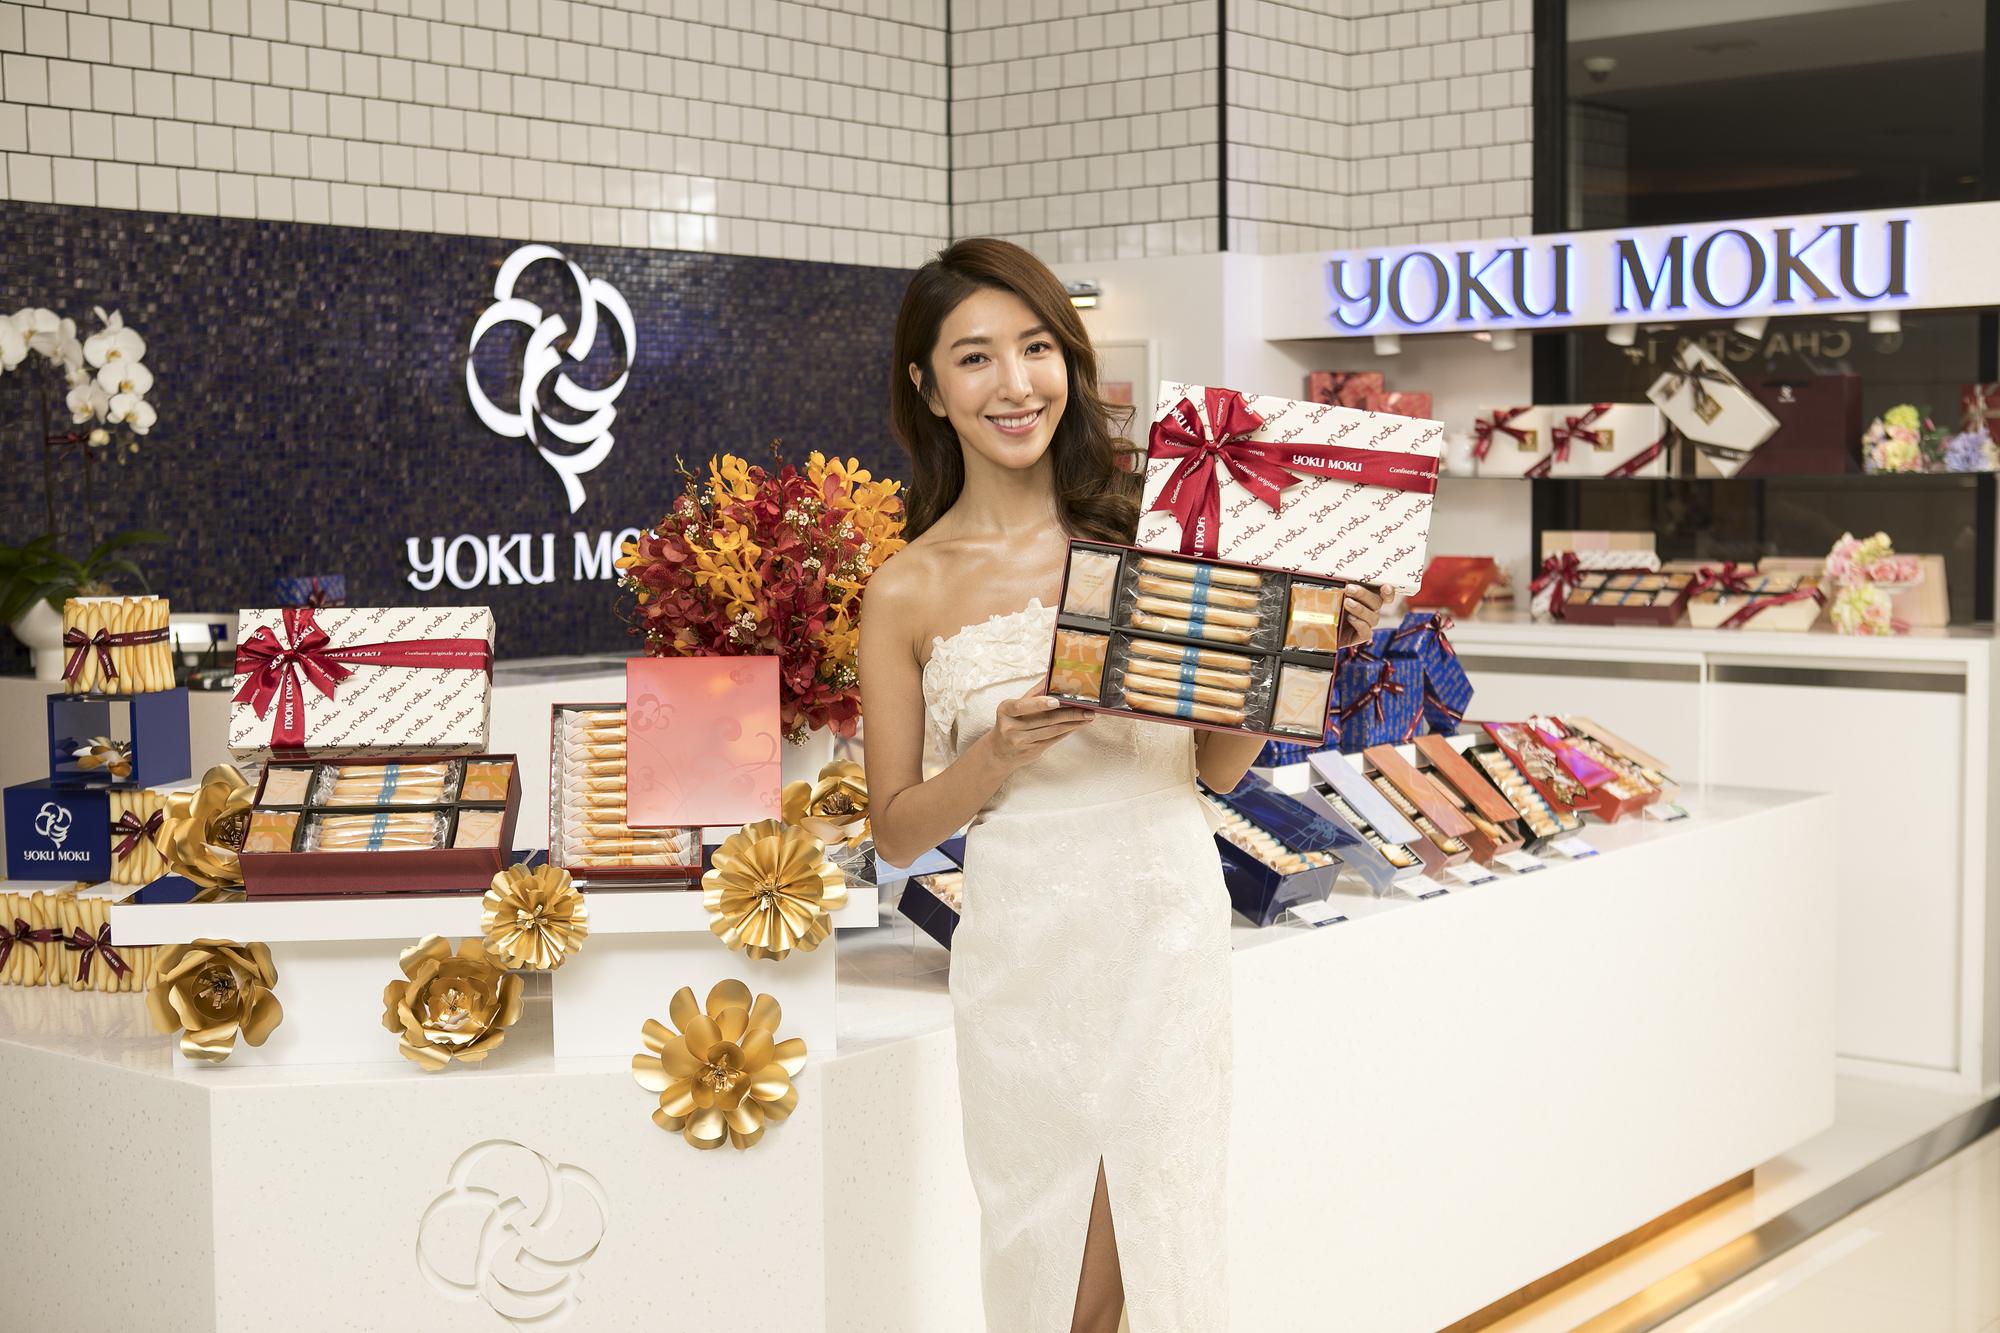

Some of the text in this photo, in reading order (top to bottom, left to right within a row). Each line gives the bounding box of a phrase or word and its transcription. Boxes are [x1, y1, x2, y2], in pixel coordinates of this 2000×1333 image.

[1330, 219, 1911, 328] YOKU MOKU
[1292, 454, 1362, 472] YOKU MOKU
[1194, 516, 1206, 549] YOKU
[406, 527, 642, 591] YOKU MO
[284, 703, 294, 730] MOKU
[23, 850, 90, 861] YOKU MOKU
